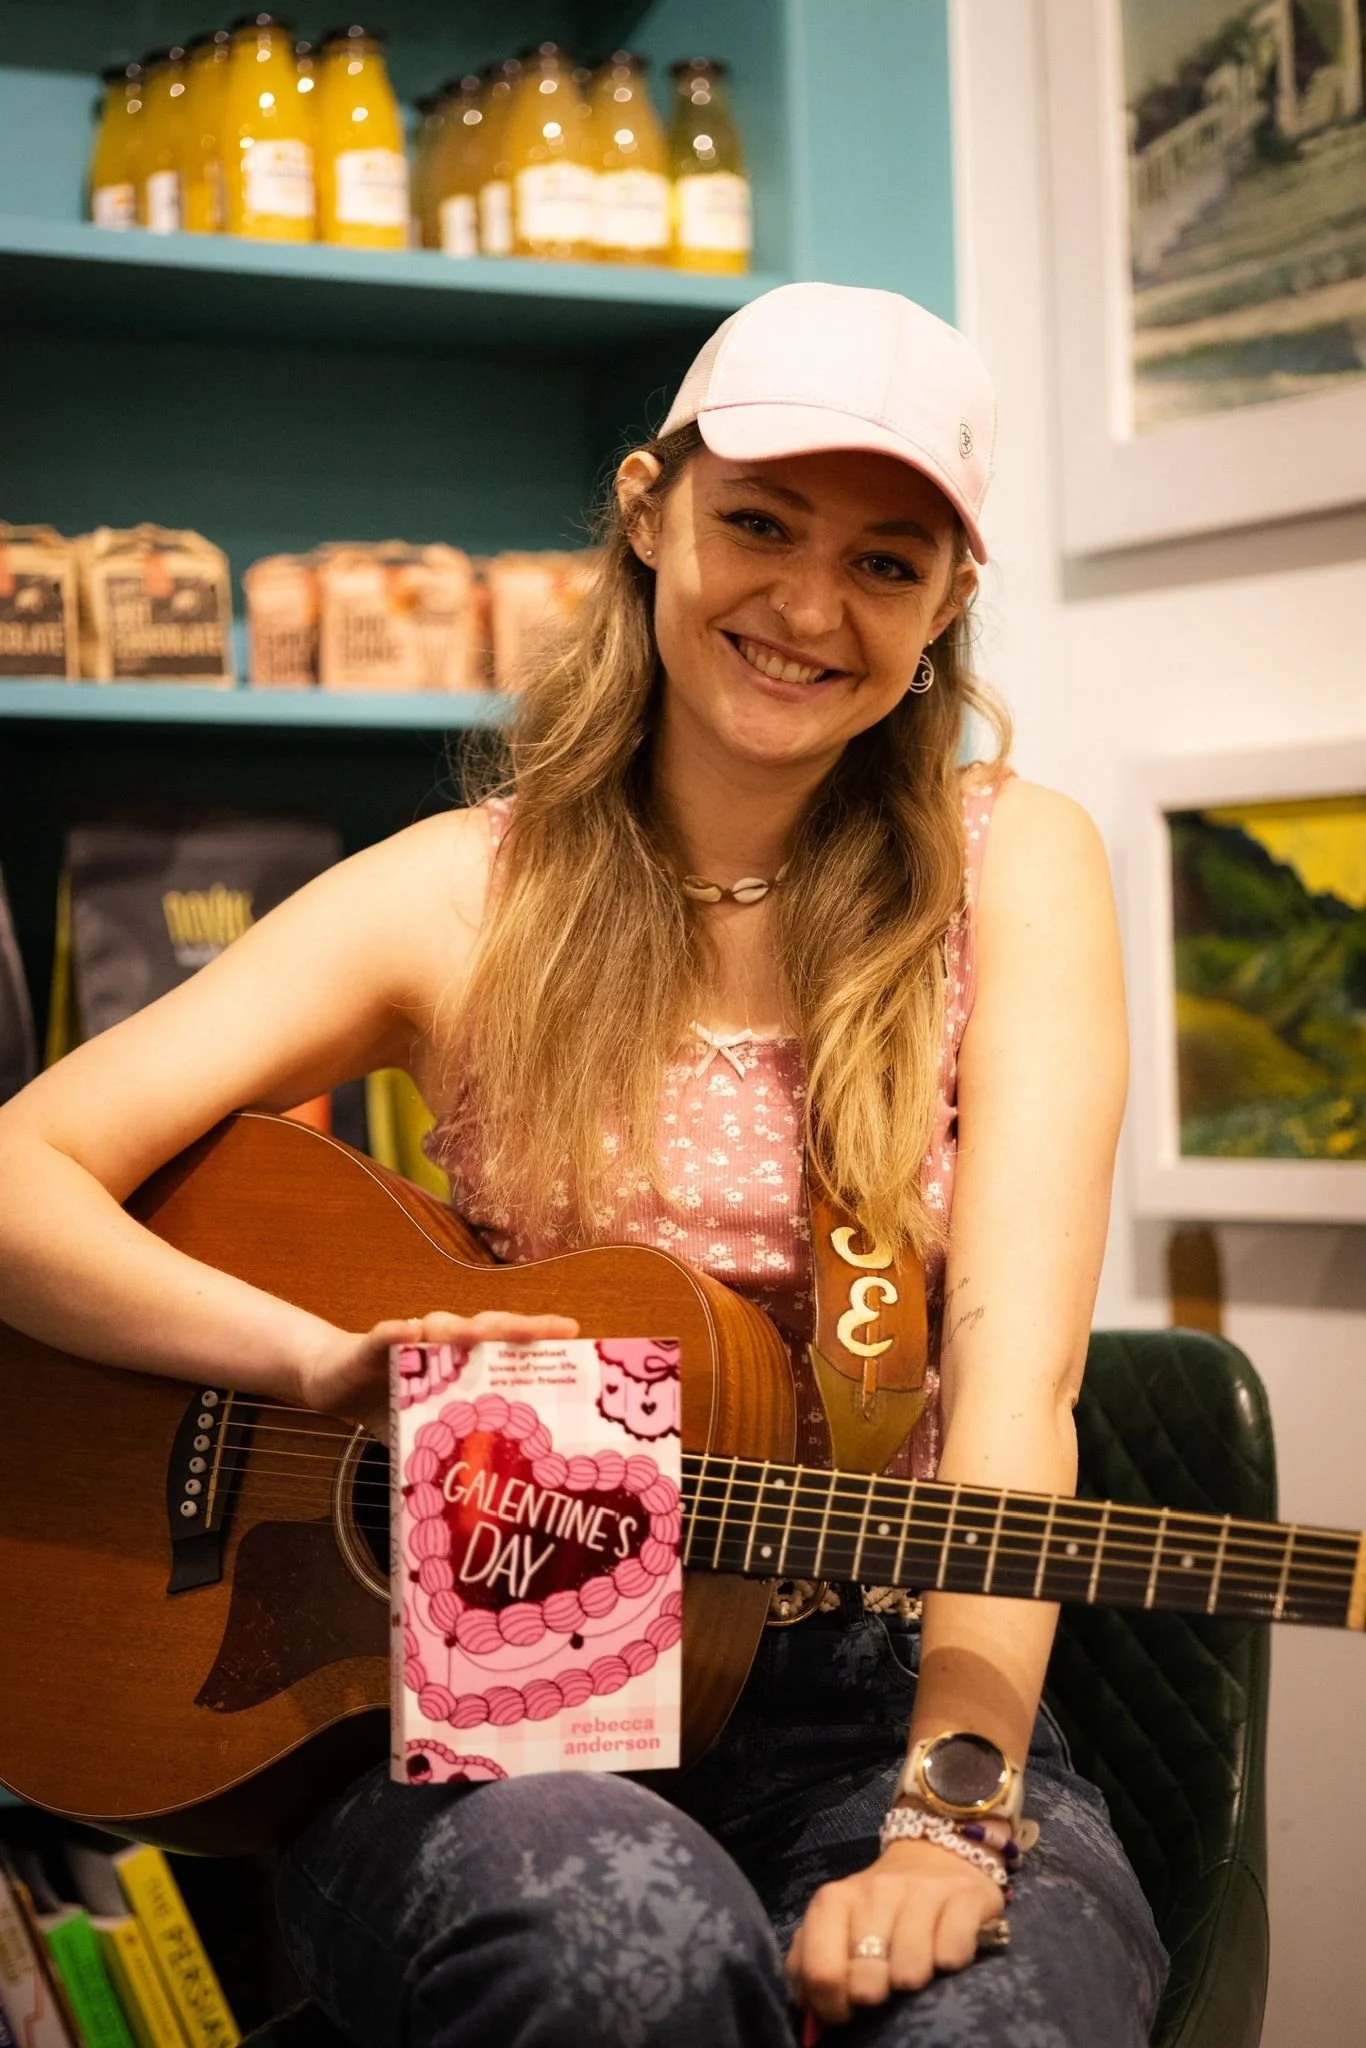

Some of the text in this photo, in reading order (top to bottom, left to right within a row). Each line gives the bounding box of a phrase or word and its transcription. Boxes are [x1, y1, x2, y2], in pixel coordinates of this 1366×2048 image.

[443, 1461, 638, 1559] GALENTINE'S
[459, 1520, 555, 1599] DAY
[564, 1736, 661, 1755] anderson
[571, 1716, 655, 1734] rebecca
